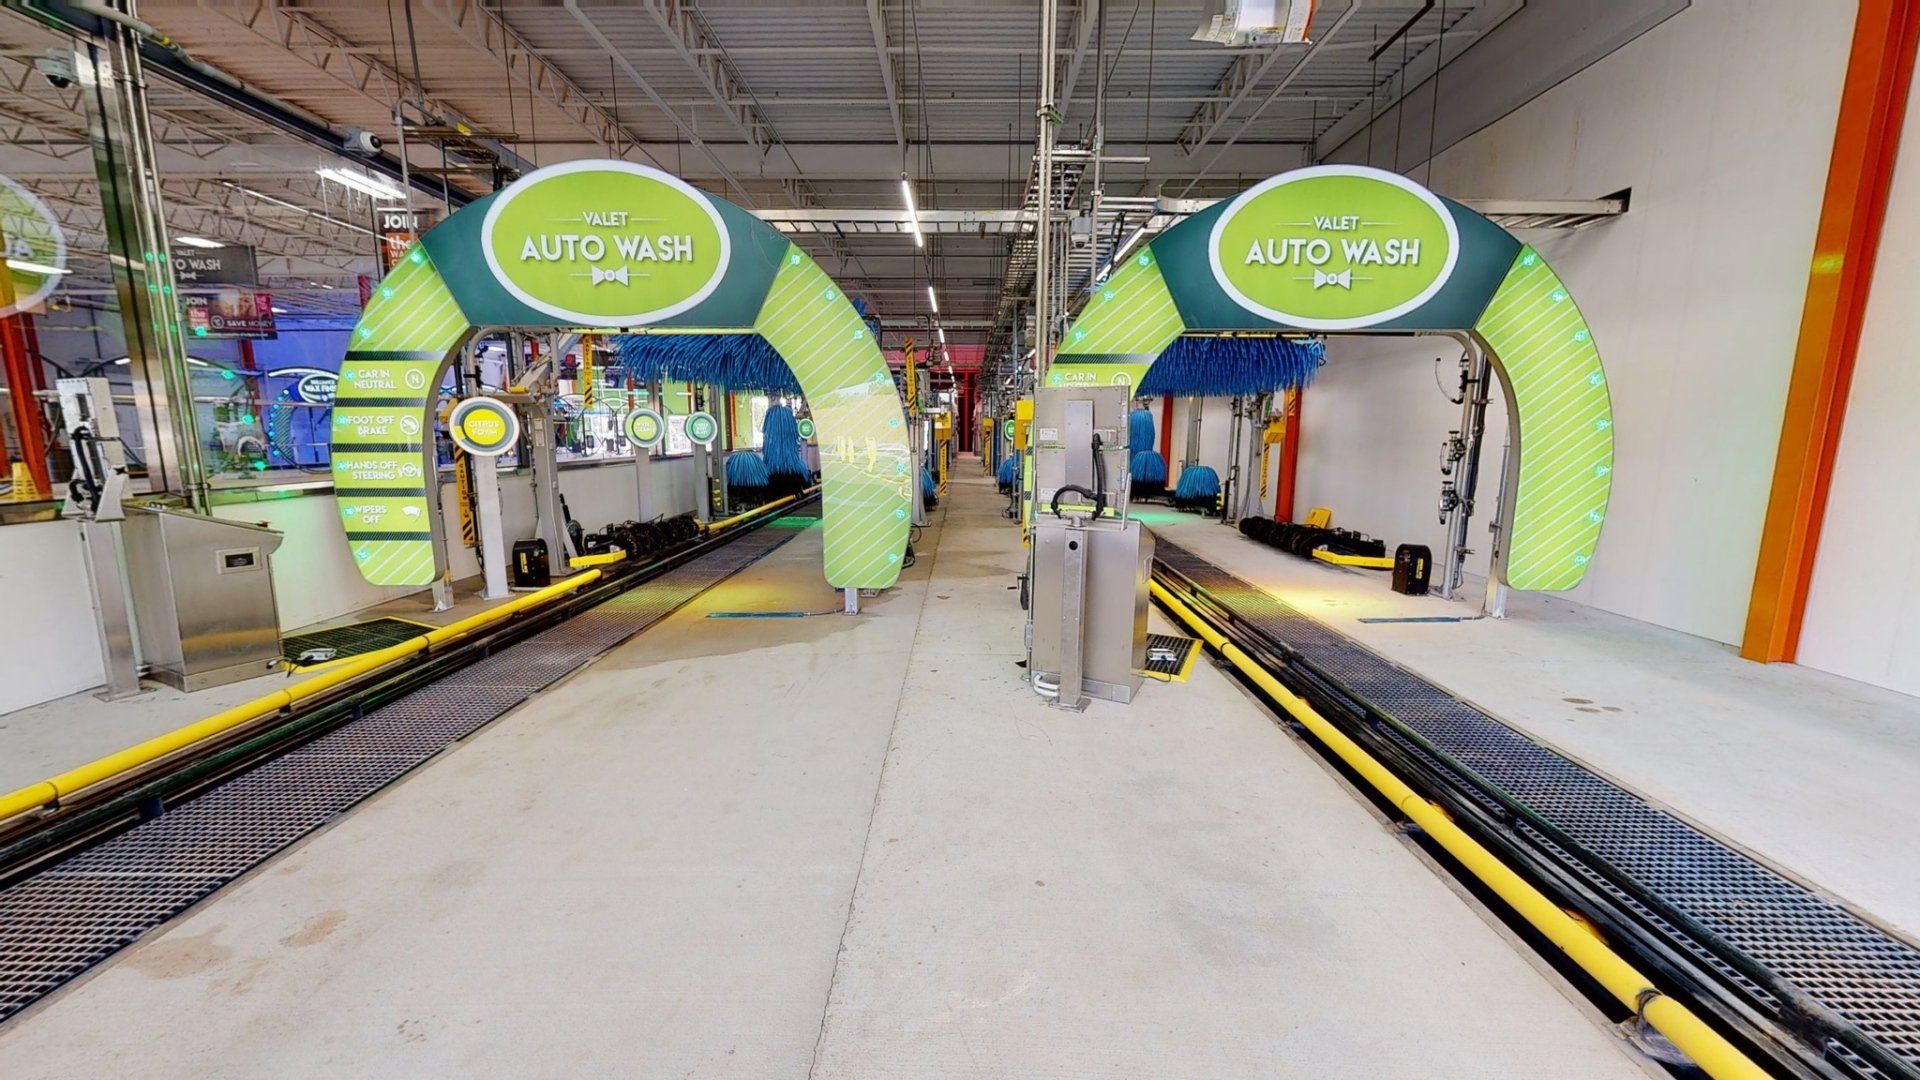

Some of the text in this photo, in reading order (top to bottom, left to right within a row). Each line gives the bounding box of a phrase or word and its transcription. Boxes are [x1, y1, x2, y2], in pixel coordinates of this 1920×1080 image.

[583, 211, 628, 226] VALET
[1313, 216, 1360, 230] VALET
[520, 234, 693, 262] AUTO WASH
[1244, 238, 1420, 265] AUTO WASH
[189, 259, 221, 270] WASH
[186, 297, 208, 305] JOIN
[358, 369, 390, 379] CAR IN
[1064, 372, 1097, 381] CAR IN
[354, 380, 397, 390] NEUTRAL
[348, 415, 394, 425] FOOT OFF
[357, 426, 389, 436] BRAKE
[347, 460, 398, 470] HANDS OFF
[352, 471, 396, 480] STEERING
[355, 505, 387, 514] WIPERS
[362, 515, 380, 524] OFF
